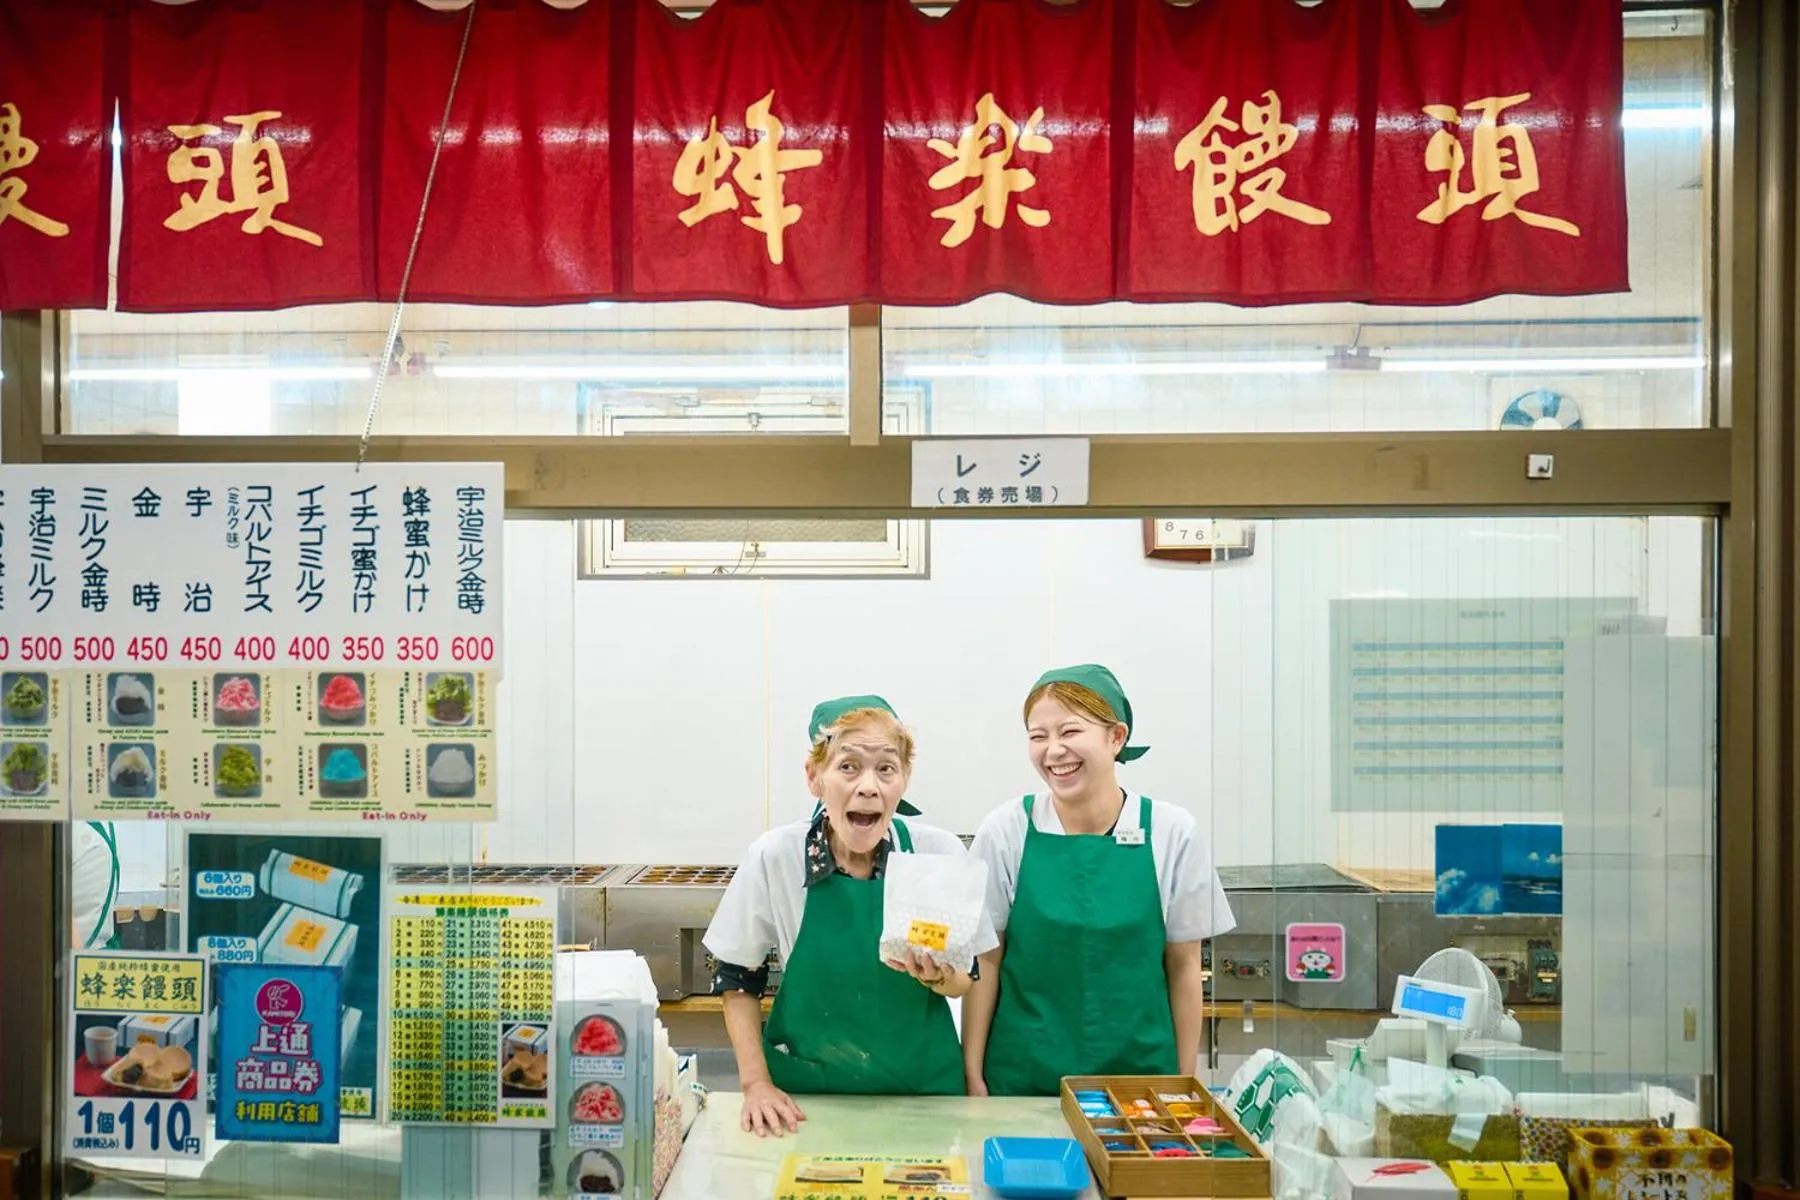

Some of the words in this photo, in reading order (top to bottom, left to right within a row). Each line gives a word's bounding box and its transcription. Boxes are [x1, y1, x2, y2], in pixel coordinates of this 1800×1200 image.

[672, 89, 1580, 264] 蜂楽饅頭
[956, 453, 1042, 478] レジ
[937, 486, 1059, 504] (食券売場)
[1165, 521, 1174, 532] 8
[1180, 529, 1188, 540] 7
[1195, 529, 1204, 540] 6
[28, 486, 56, 613] 宇治ミルク
[79, 486, 109, 613] ミルク金時
[131, 486, 162, 613] 金時
[184, 486, 213, 613] 宇治
[245, 485, 273, 614] コバルトアイス
[296, 485, 327, 614] イチゴミルク
[349, 485, 380, 614] イチゴ蜜かけ
[402, 485, 431, 614] 蜂蜜かけ
[456, 485, 487, 614] 宇治ミルク金時
[21, 636, 61, 661] 500
[74, 636, 115, 661] 500
[127, 636, 168, 661] 450
[180, 636, 221, 661] 450
[234, 636, 275, 661] 400
[288, 636, 330, 661] 400
[342, 636, 384, 661] 350
[396, 636, 439, 661] 350
[451, 636, 494, 661] 600
[184, 811, 212, 821] Only
[400, 812, 428, 822] Only
[81, 972, 197, 1001] 蜂楽饅頭
[251, 1023, 309, 1055] 上通
[236, 1058, 320, 1092] 商品券
[236, 1101, 320, 1123] 利用店舗
